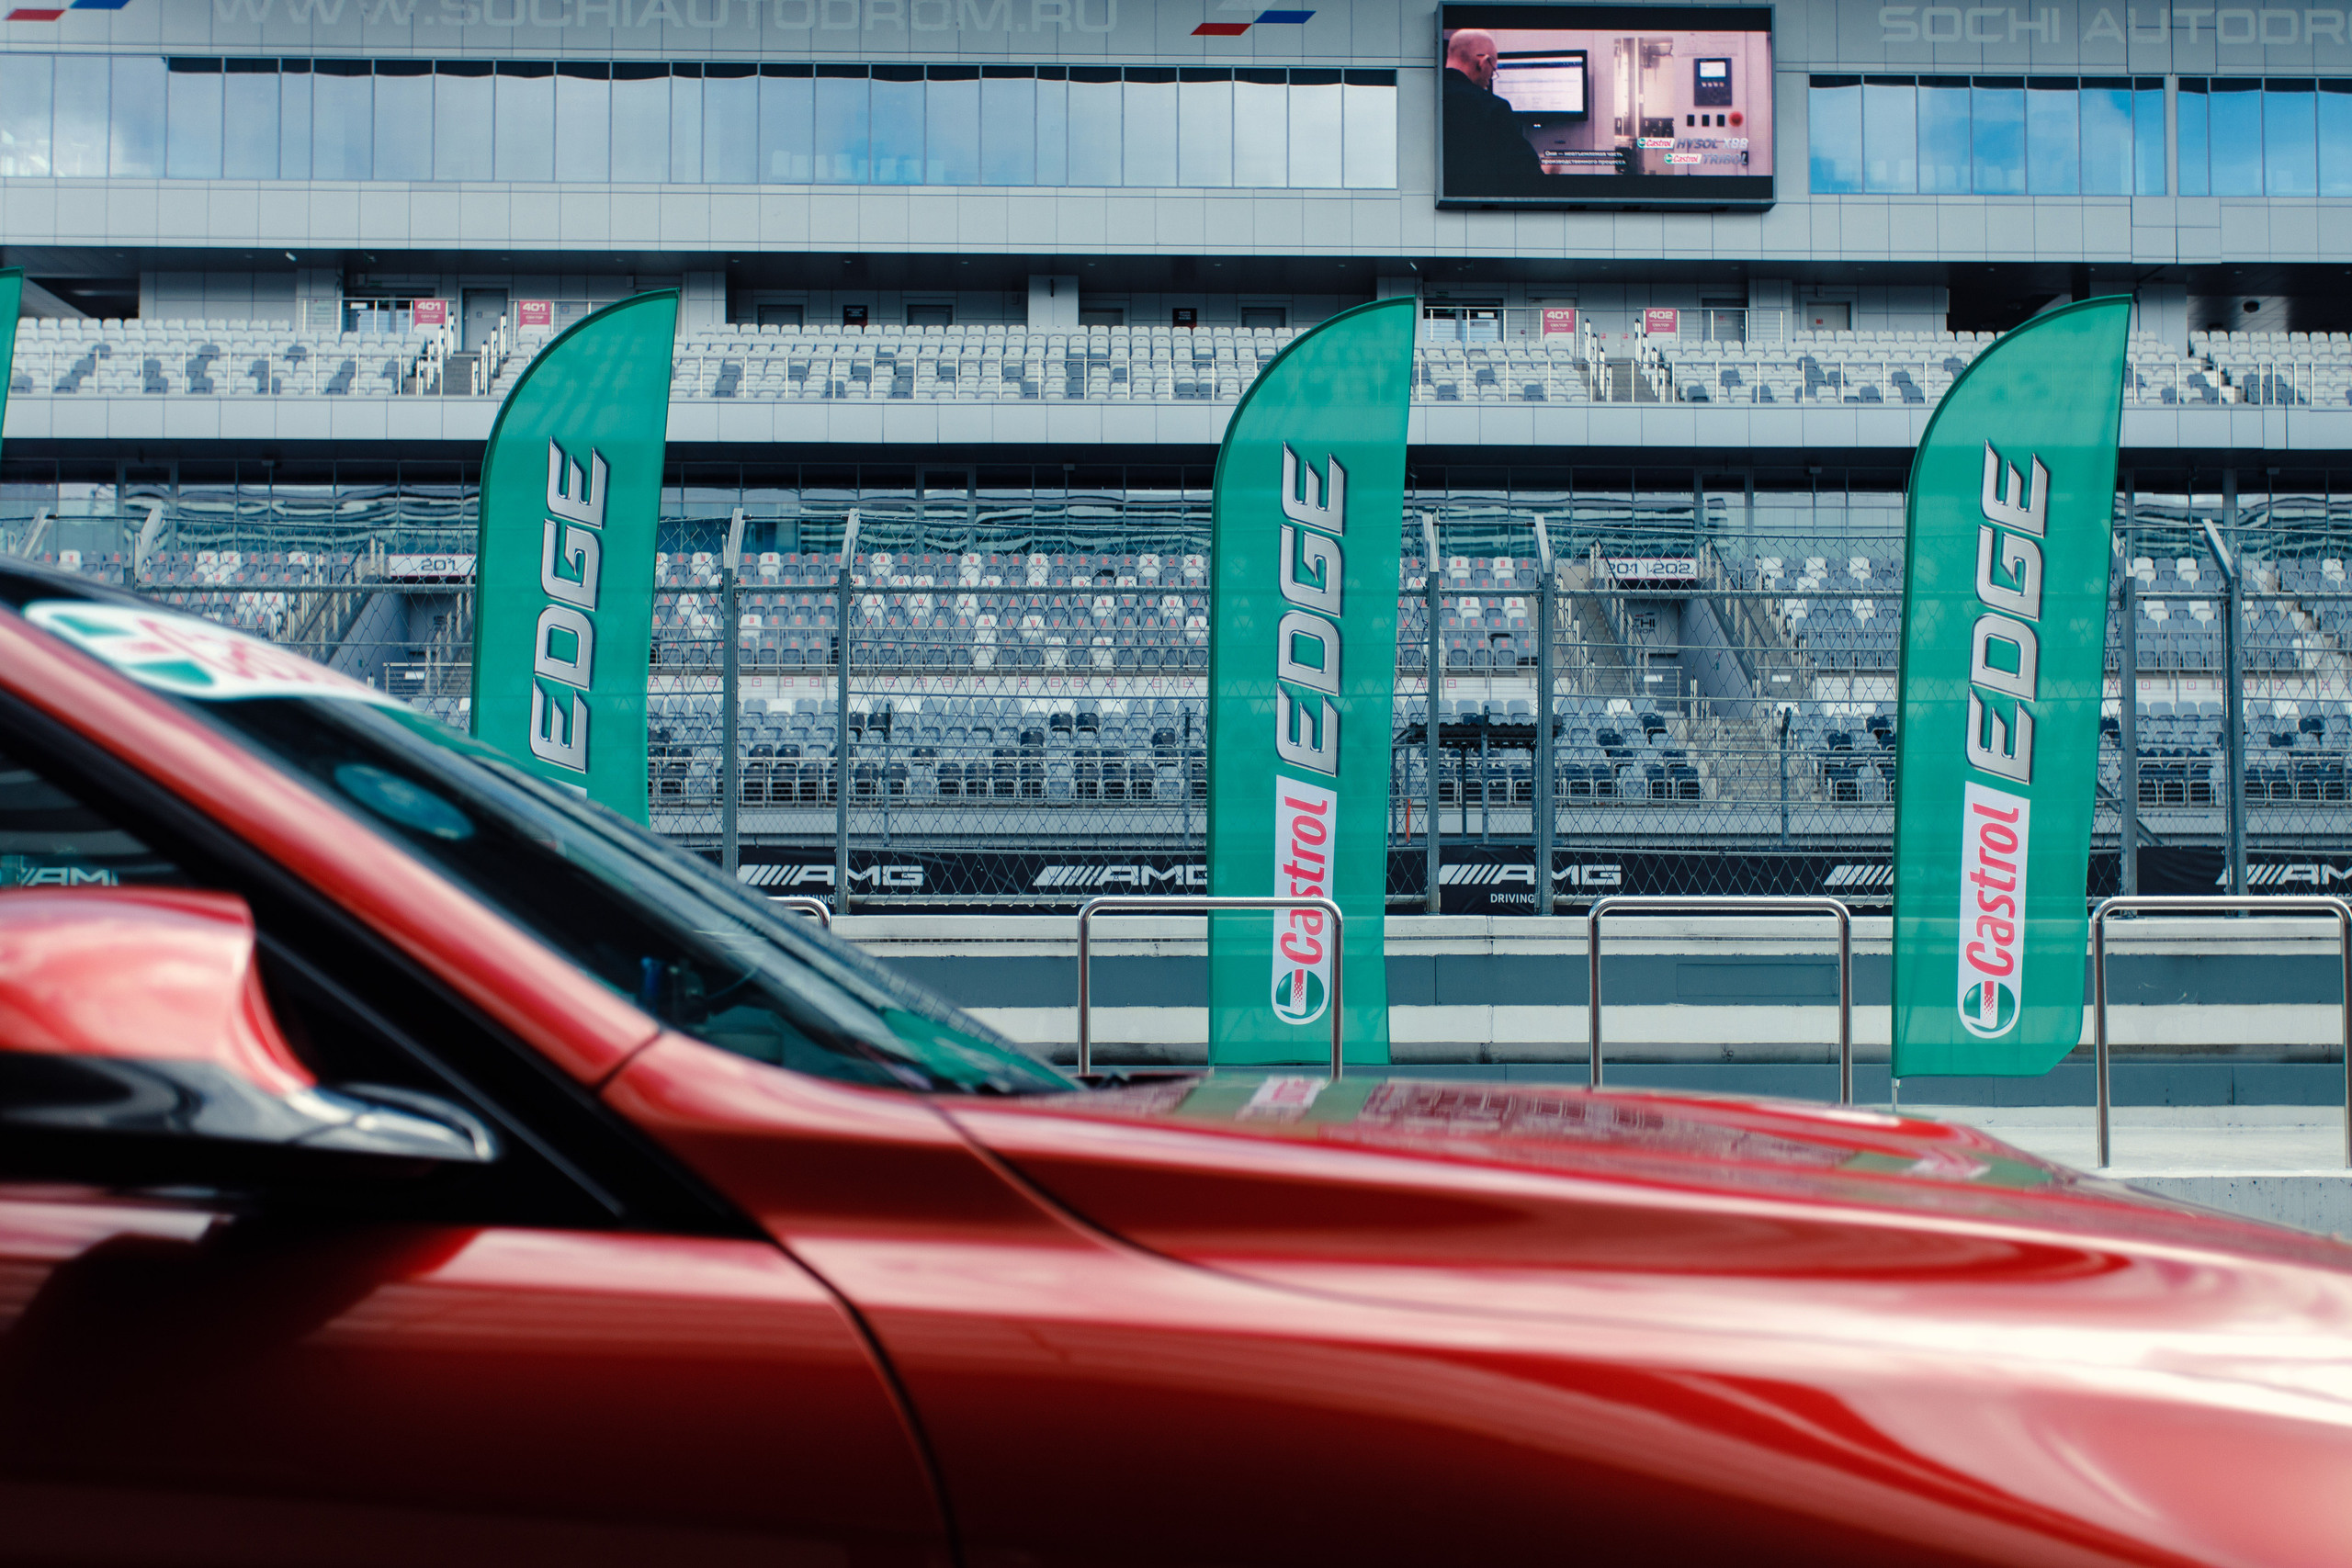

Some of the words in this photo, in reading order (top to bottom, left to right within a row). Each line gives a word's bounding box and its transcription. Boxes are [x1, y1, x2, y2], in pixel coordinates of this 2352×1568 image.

[216, 0, 1118, 33] WWW.SOCHIAUTODROM.RU
[1878, 6, 2061, 44] SOCHI
[2083, 7, 2352, 46] AUTODR
[1645, 139, 1672, 148] Castrol
[1677, 139, 1717, 149] HYSOL
[1672, 154, 1699, 164] Castrol
[1702, 153, 1748, 165] TRIBOL
[417, 301, 441, 310] 401
[522, 302, 546, 311] 401
[1546, 310, 1569, 320] 401
[1648, 310, 1674, 320] 402
[420, 559, 456, 571] 201
[1653, 563, 1690, 574] 202
[529, 435, 607, 774] EDGE
[1275, 440, 1344, 778] EDGE
[1965, 439, 2048, 785] EDGE
[789, 864, 924, 886] AMG
[1279, 795, 1329, 965] Castrol
[1490, 863, 1622, 886] AMG
[1965, 802, 2020, 977] Castrol
[1490, 893, 1535, 904] DRIVING
